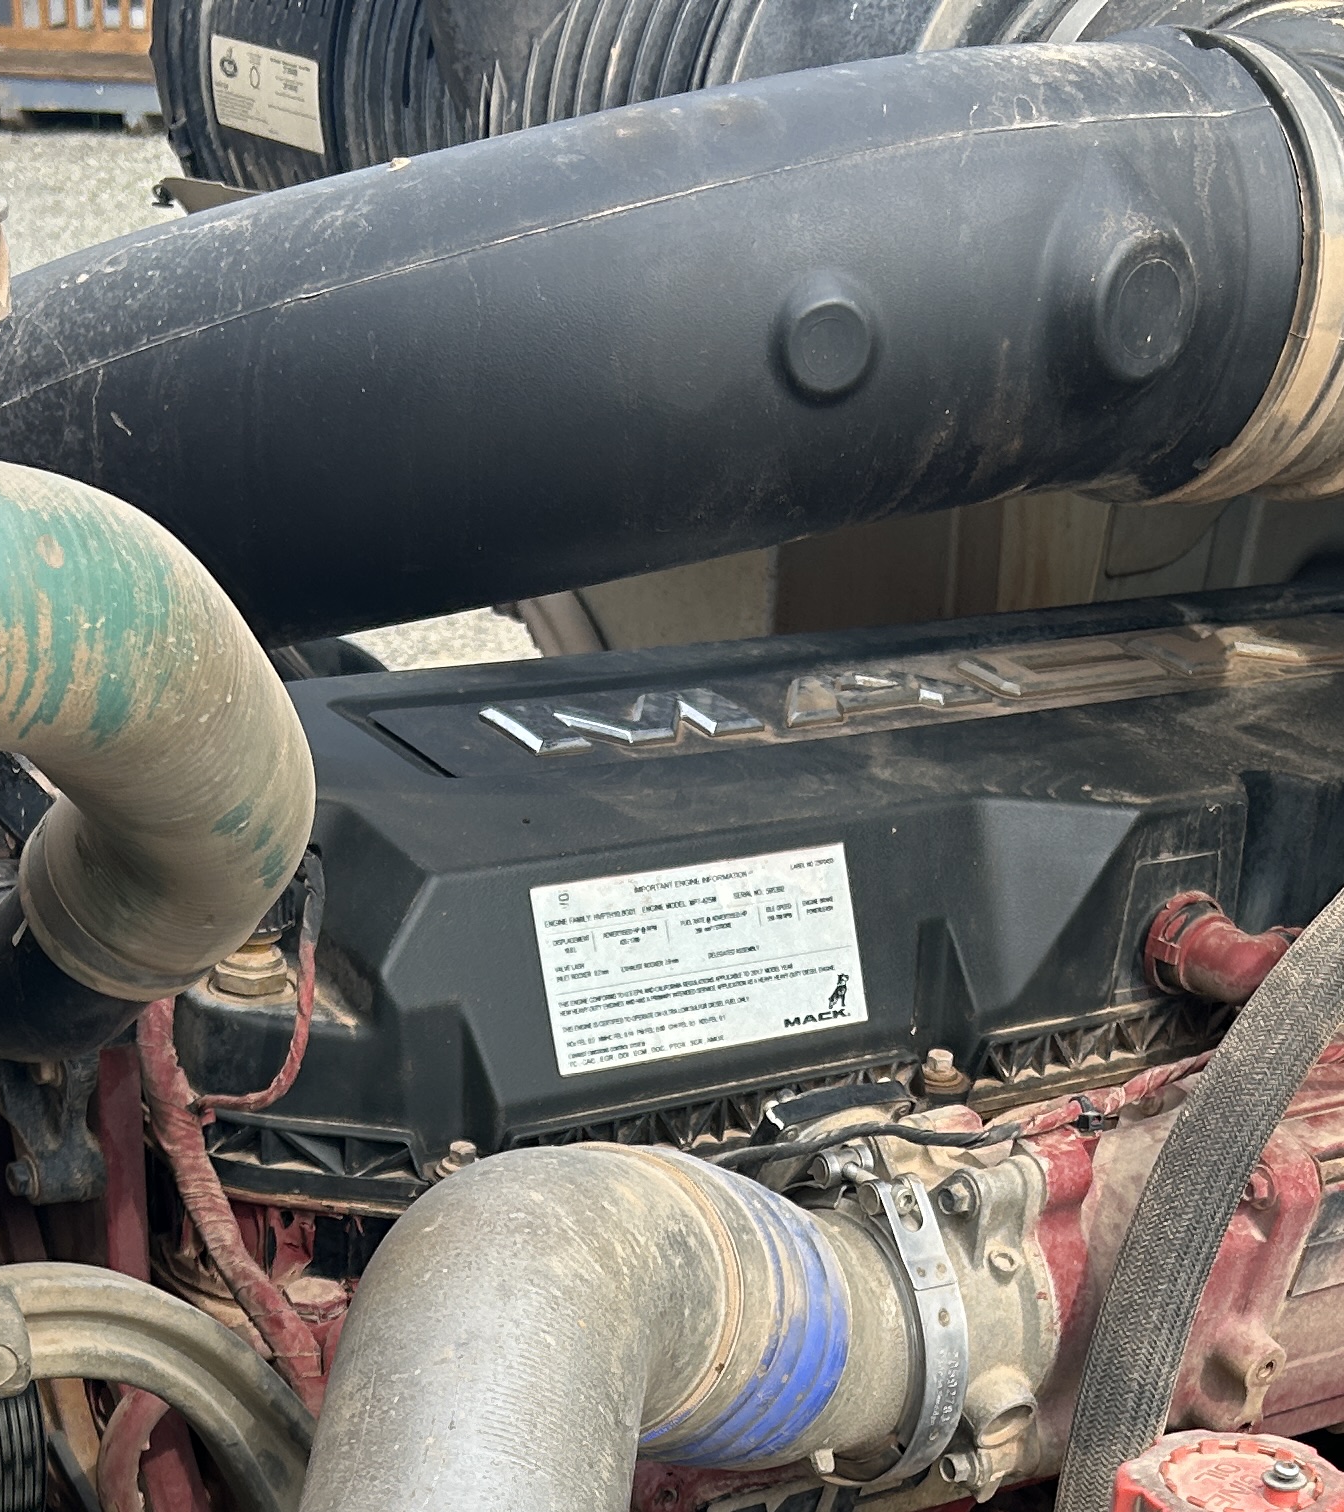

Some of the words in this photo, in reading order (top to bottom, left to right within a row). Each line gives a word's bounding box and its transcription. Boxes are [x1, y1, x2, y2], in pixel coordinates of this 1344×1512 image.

[633, 881, 672, 893] IMPORTANT
[674, 877, 699, 887] ENGINE
[701, 870, 746, 883] INFORMATION
[641, 903, 663, 914] ENGINE
[543, 918, 568, 929] ENGINE
[784, 1009, 851, 1028] MACK
